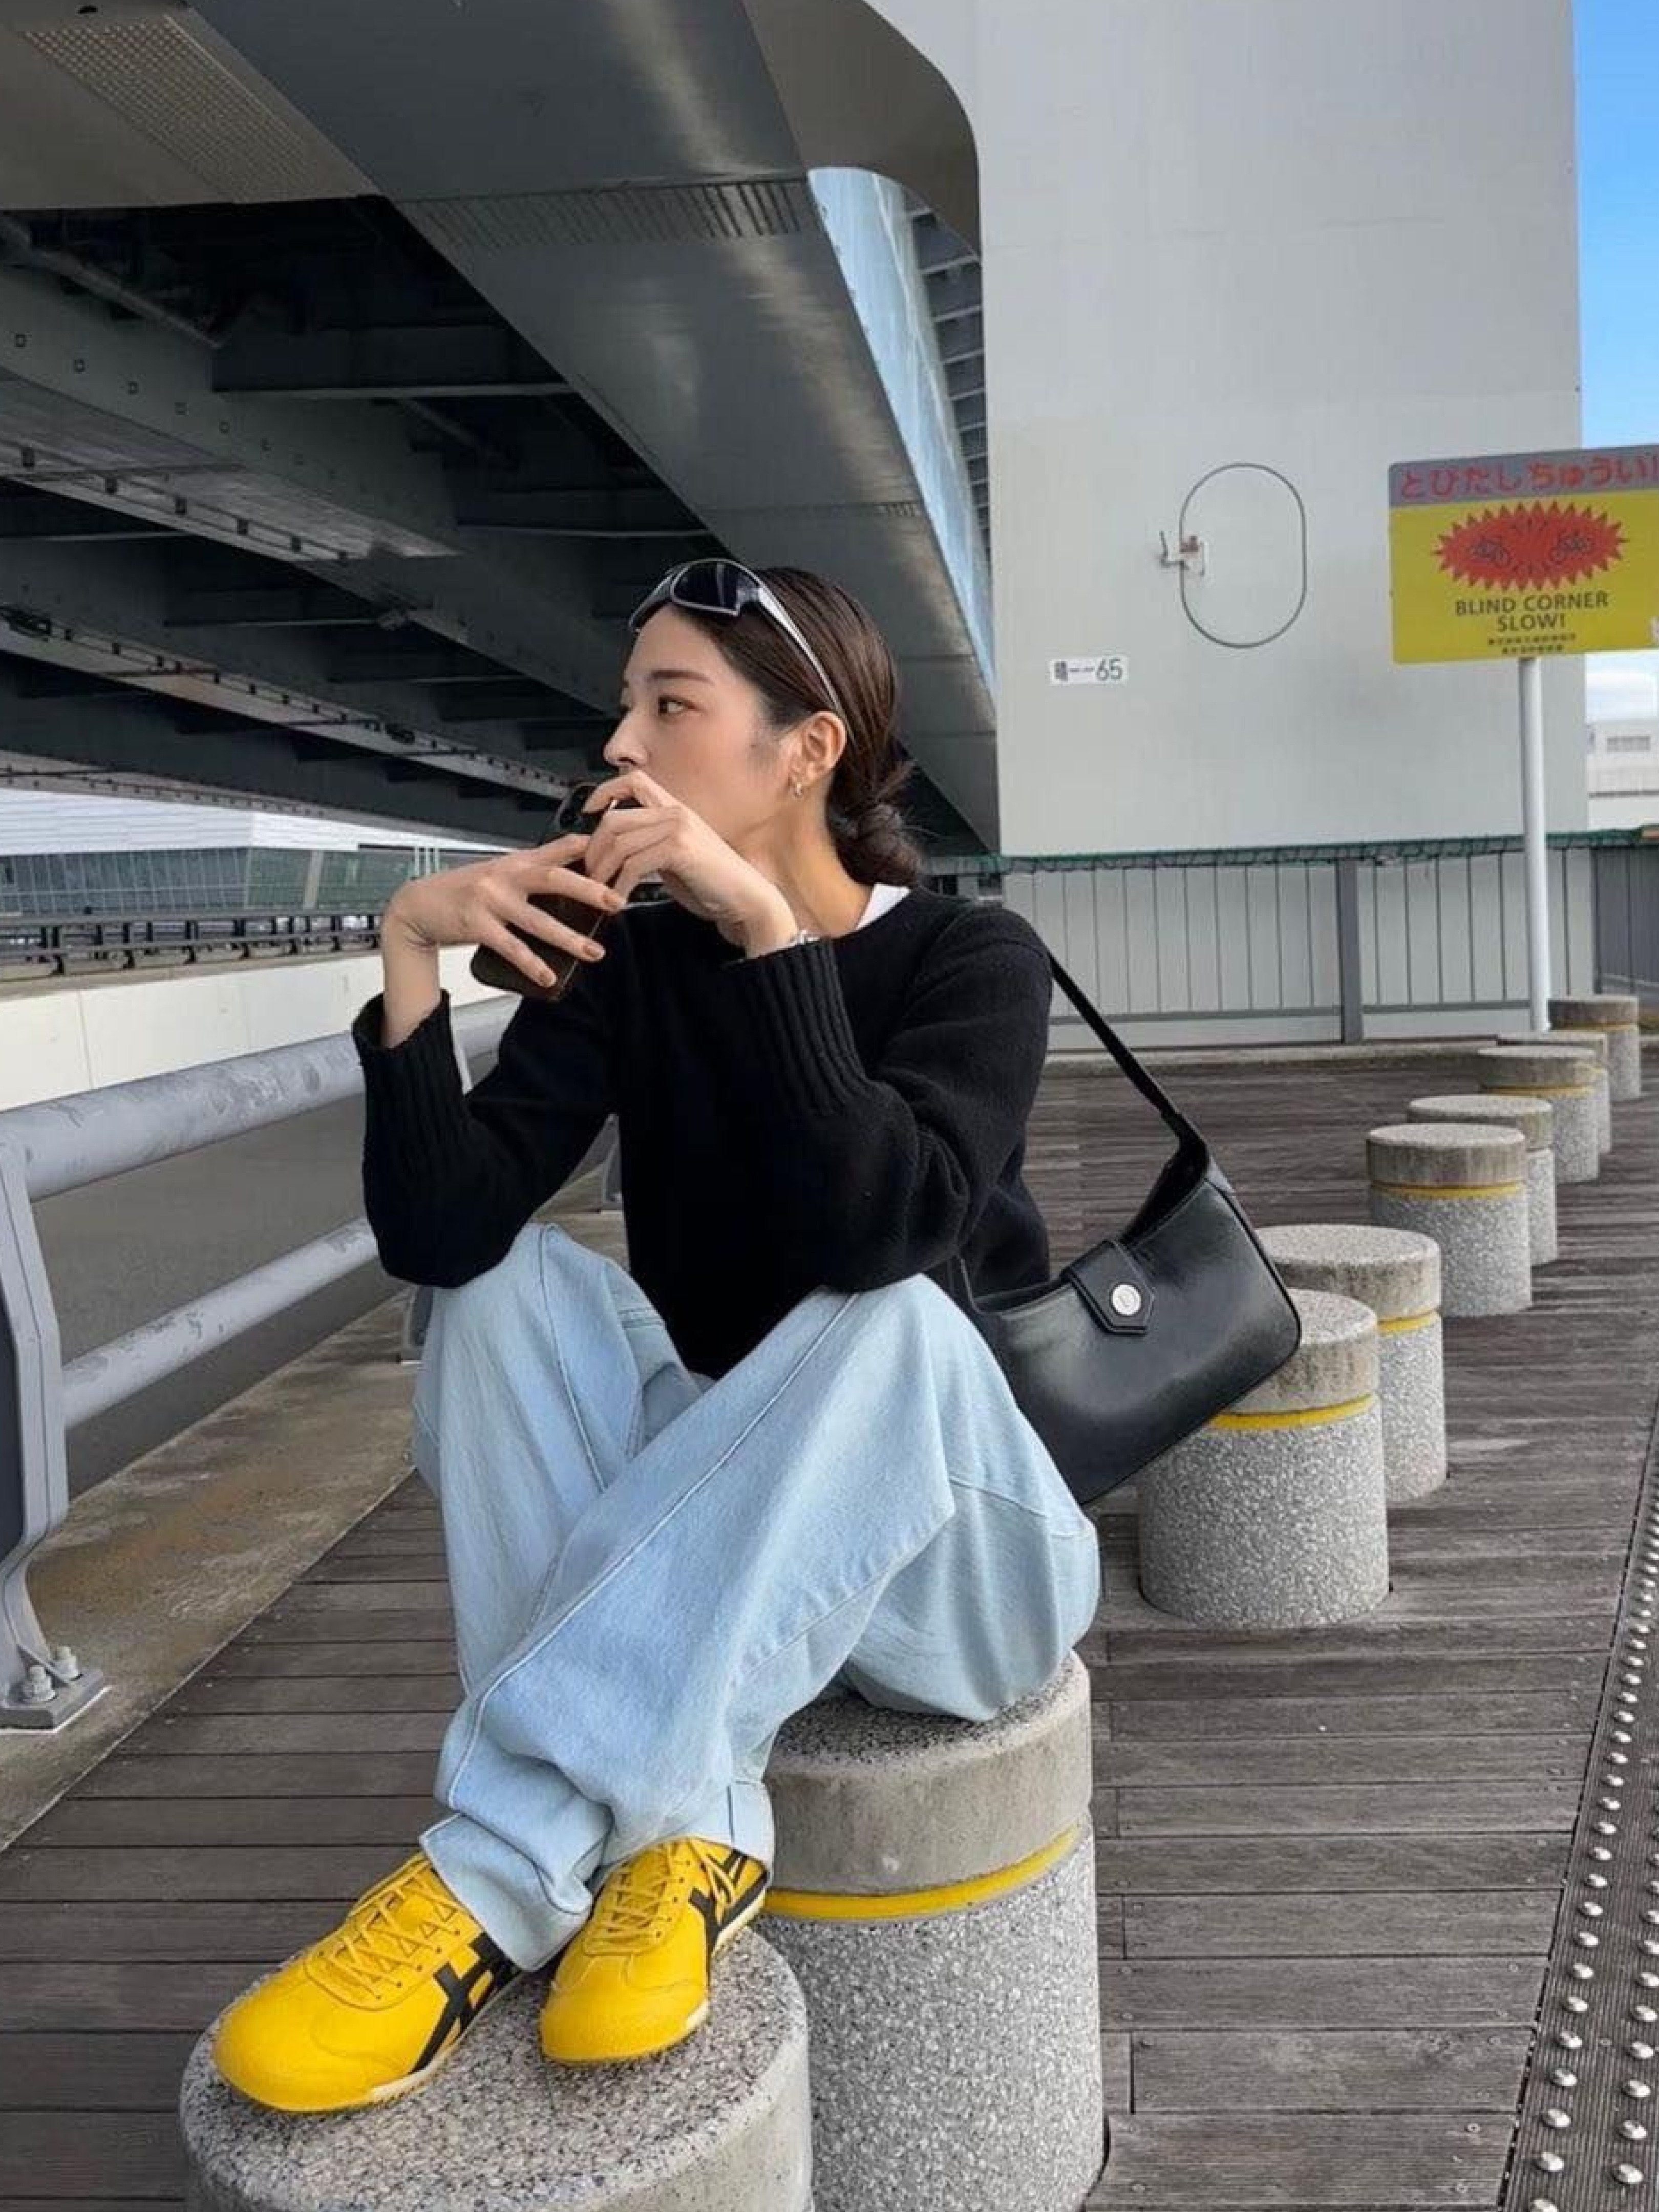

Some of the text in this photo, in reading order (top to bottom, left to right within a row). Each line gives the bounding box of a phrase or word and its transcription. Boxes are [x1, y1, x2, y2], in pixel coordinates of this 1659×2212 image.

[1455, 590, 1608, 616] BLIND CORNER
[1497, 613, 1565, 632] SLOW!
